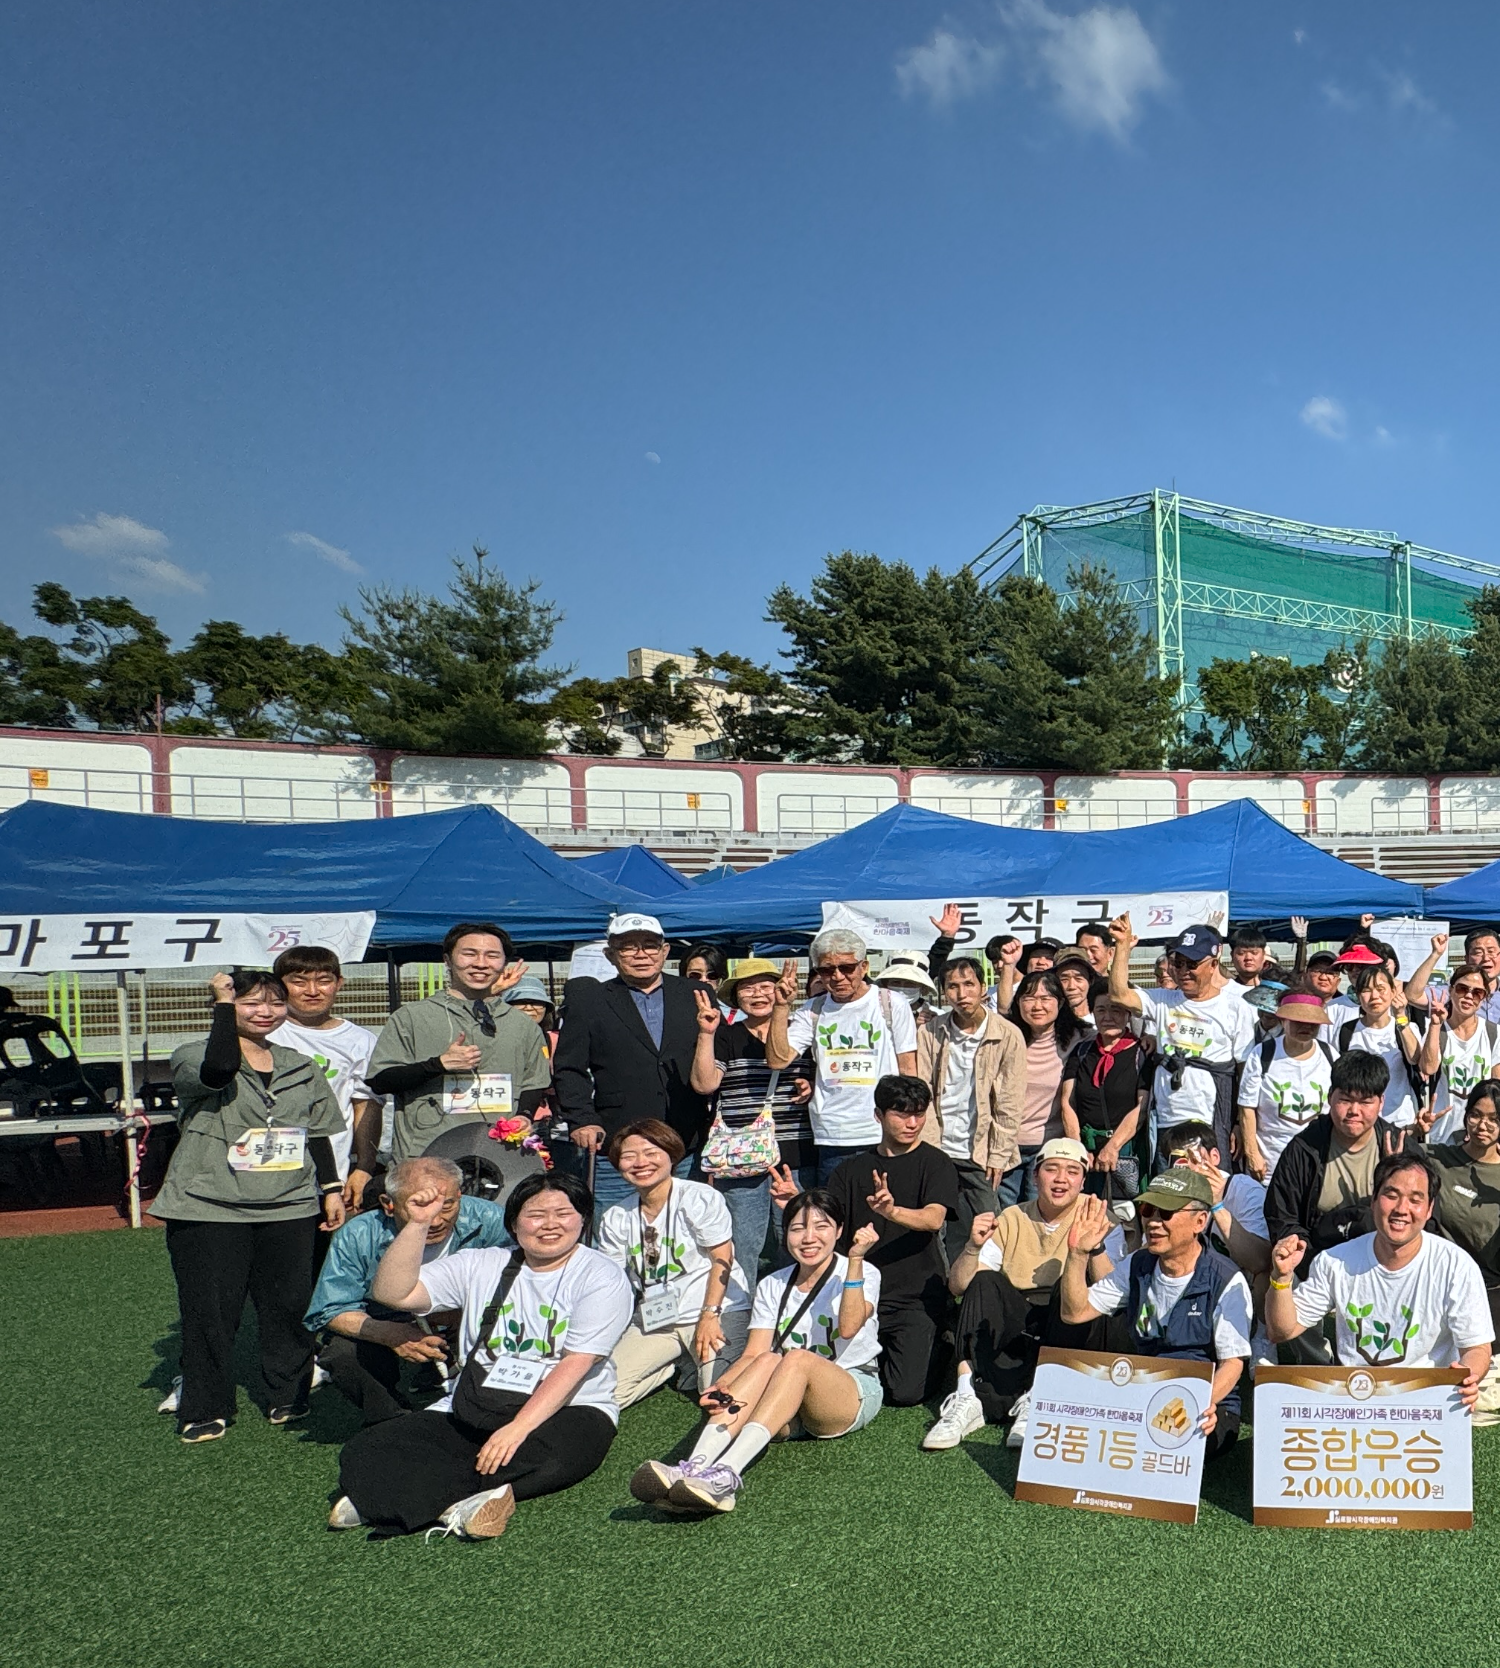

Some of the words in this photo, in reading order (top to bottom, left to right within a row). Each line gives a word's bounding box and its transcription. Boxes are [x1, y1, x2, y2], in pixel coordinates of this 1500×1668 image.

[0, 919, 223, 967] 마포구
[1180, 1025, 1204, 1038] 동작구
[843, 1062, 872, 1072] 동작구
[470, 1087, 506, 1098] 동작구
[1035, 1401, 1056, 1413] 제11회
[1056, 1404, 1106, 1419] 시각장애인가족
[1106, 1409, 1143, 1423] 한마음축제
[1281, 1407, 1312, 1419] 제11회
[1313, 1407, 1387, 1420] 시각장애인가족
[1389, 1408, 1443, 1421] 한마음축제
[1033, 1422, 1090, 1464] 경품
[1098, 1429, 1138, 1470] 1등
[1141, 1450, 1192, 1477] 골드바
[1280, 1427, 1444, 1474] 종합우승
